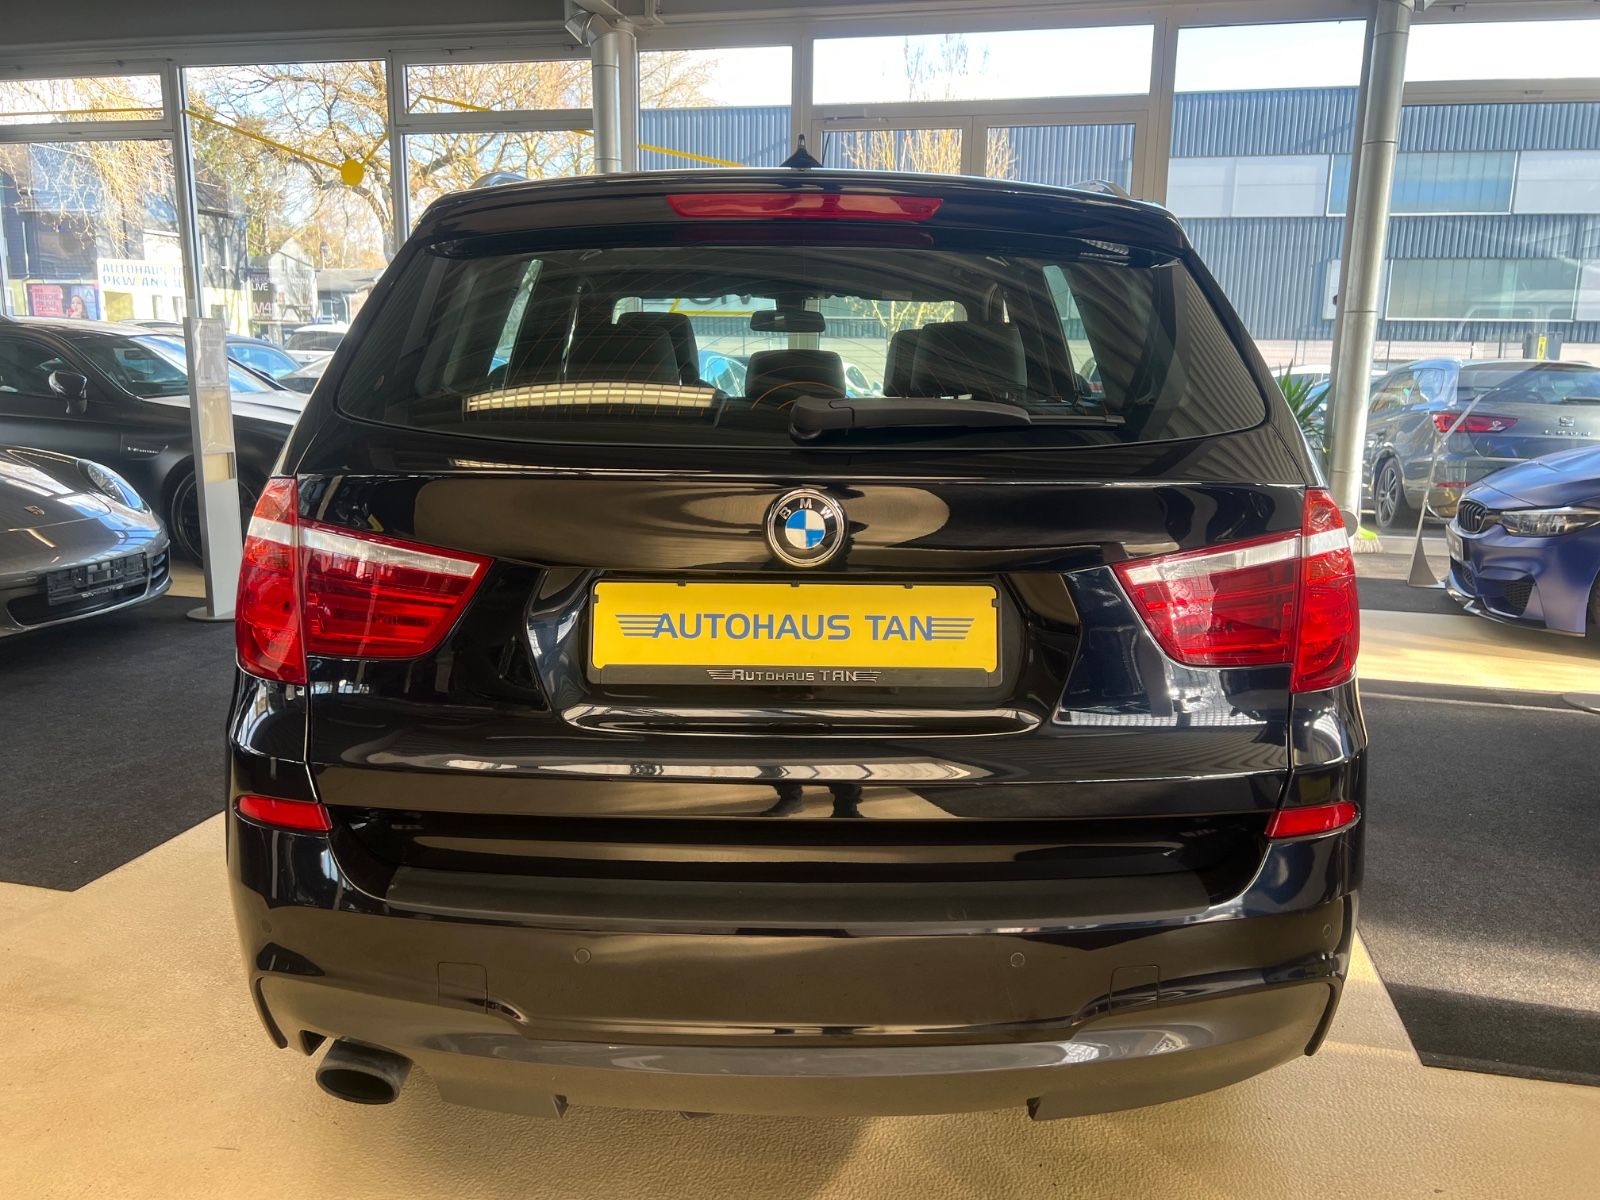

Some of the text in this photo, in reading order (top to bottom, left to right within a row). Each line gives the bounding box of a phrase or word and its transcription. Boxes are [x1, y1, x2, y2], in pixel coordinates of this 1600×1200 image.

[103, 276, 136, 286] PKW
[251, 282, 269, 291] LIVE
[779, 498, 834, 520] BMW
[652, 612, 933, 641] AUTOHAUS TAN
[819, 670, 857, 682] TAN
